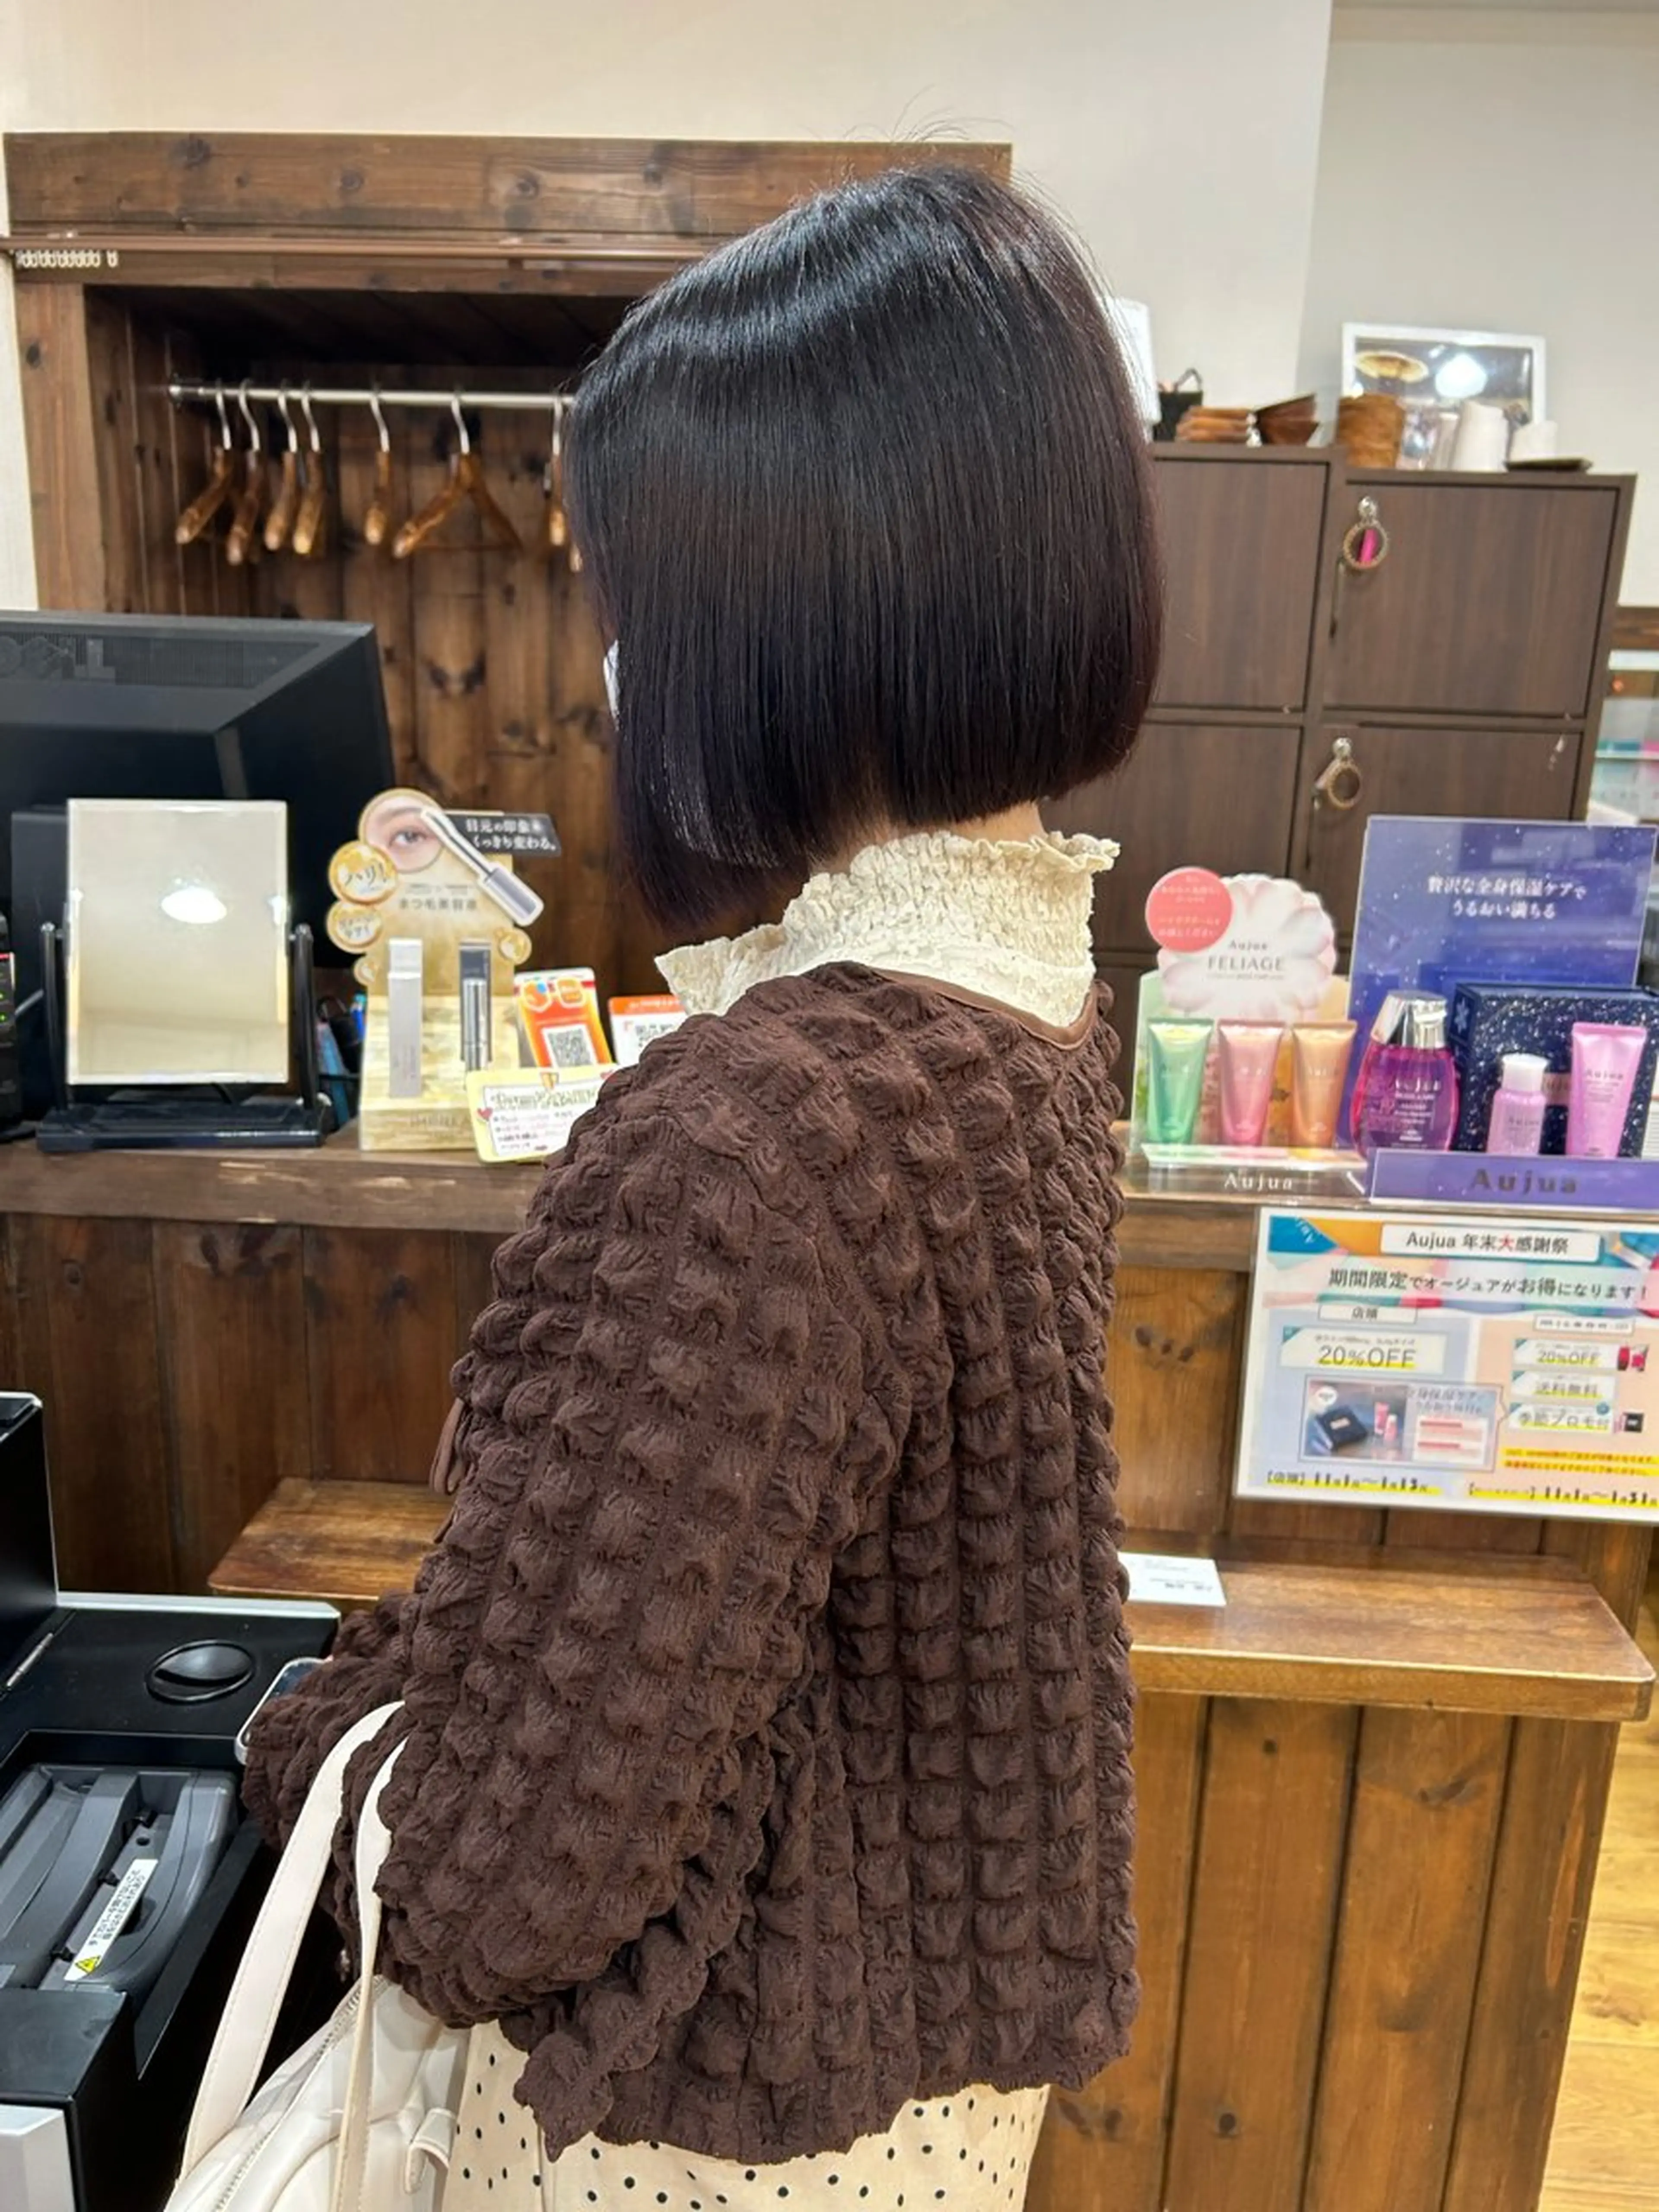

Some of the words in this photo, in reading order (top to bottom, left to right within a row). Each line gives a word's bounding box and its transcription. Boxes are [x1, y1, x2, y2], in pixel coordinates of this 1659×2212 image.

[1207, 956, 1285, 972] FELIAGE
[1224, 1173, 1294, 1191] Aujua
[1470, 1168, 1580, 1195] Aujua
[1406, 1231, 1456, 1250] Aujua
[1462, 1233, 1569, 1254] 年末大感謝祭
[1328, 1267, 1647, 1300] 期間限定でオージュアがお得になります!
[1318, 1344, 1417, 1368] 20%OFF
[1537, 1350, 1602, 1366] 20%OFF
